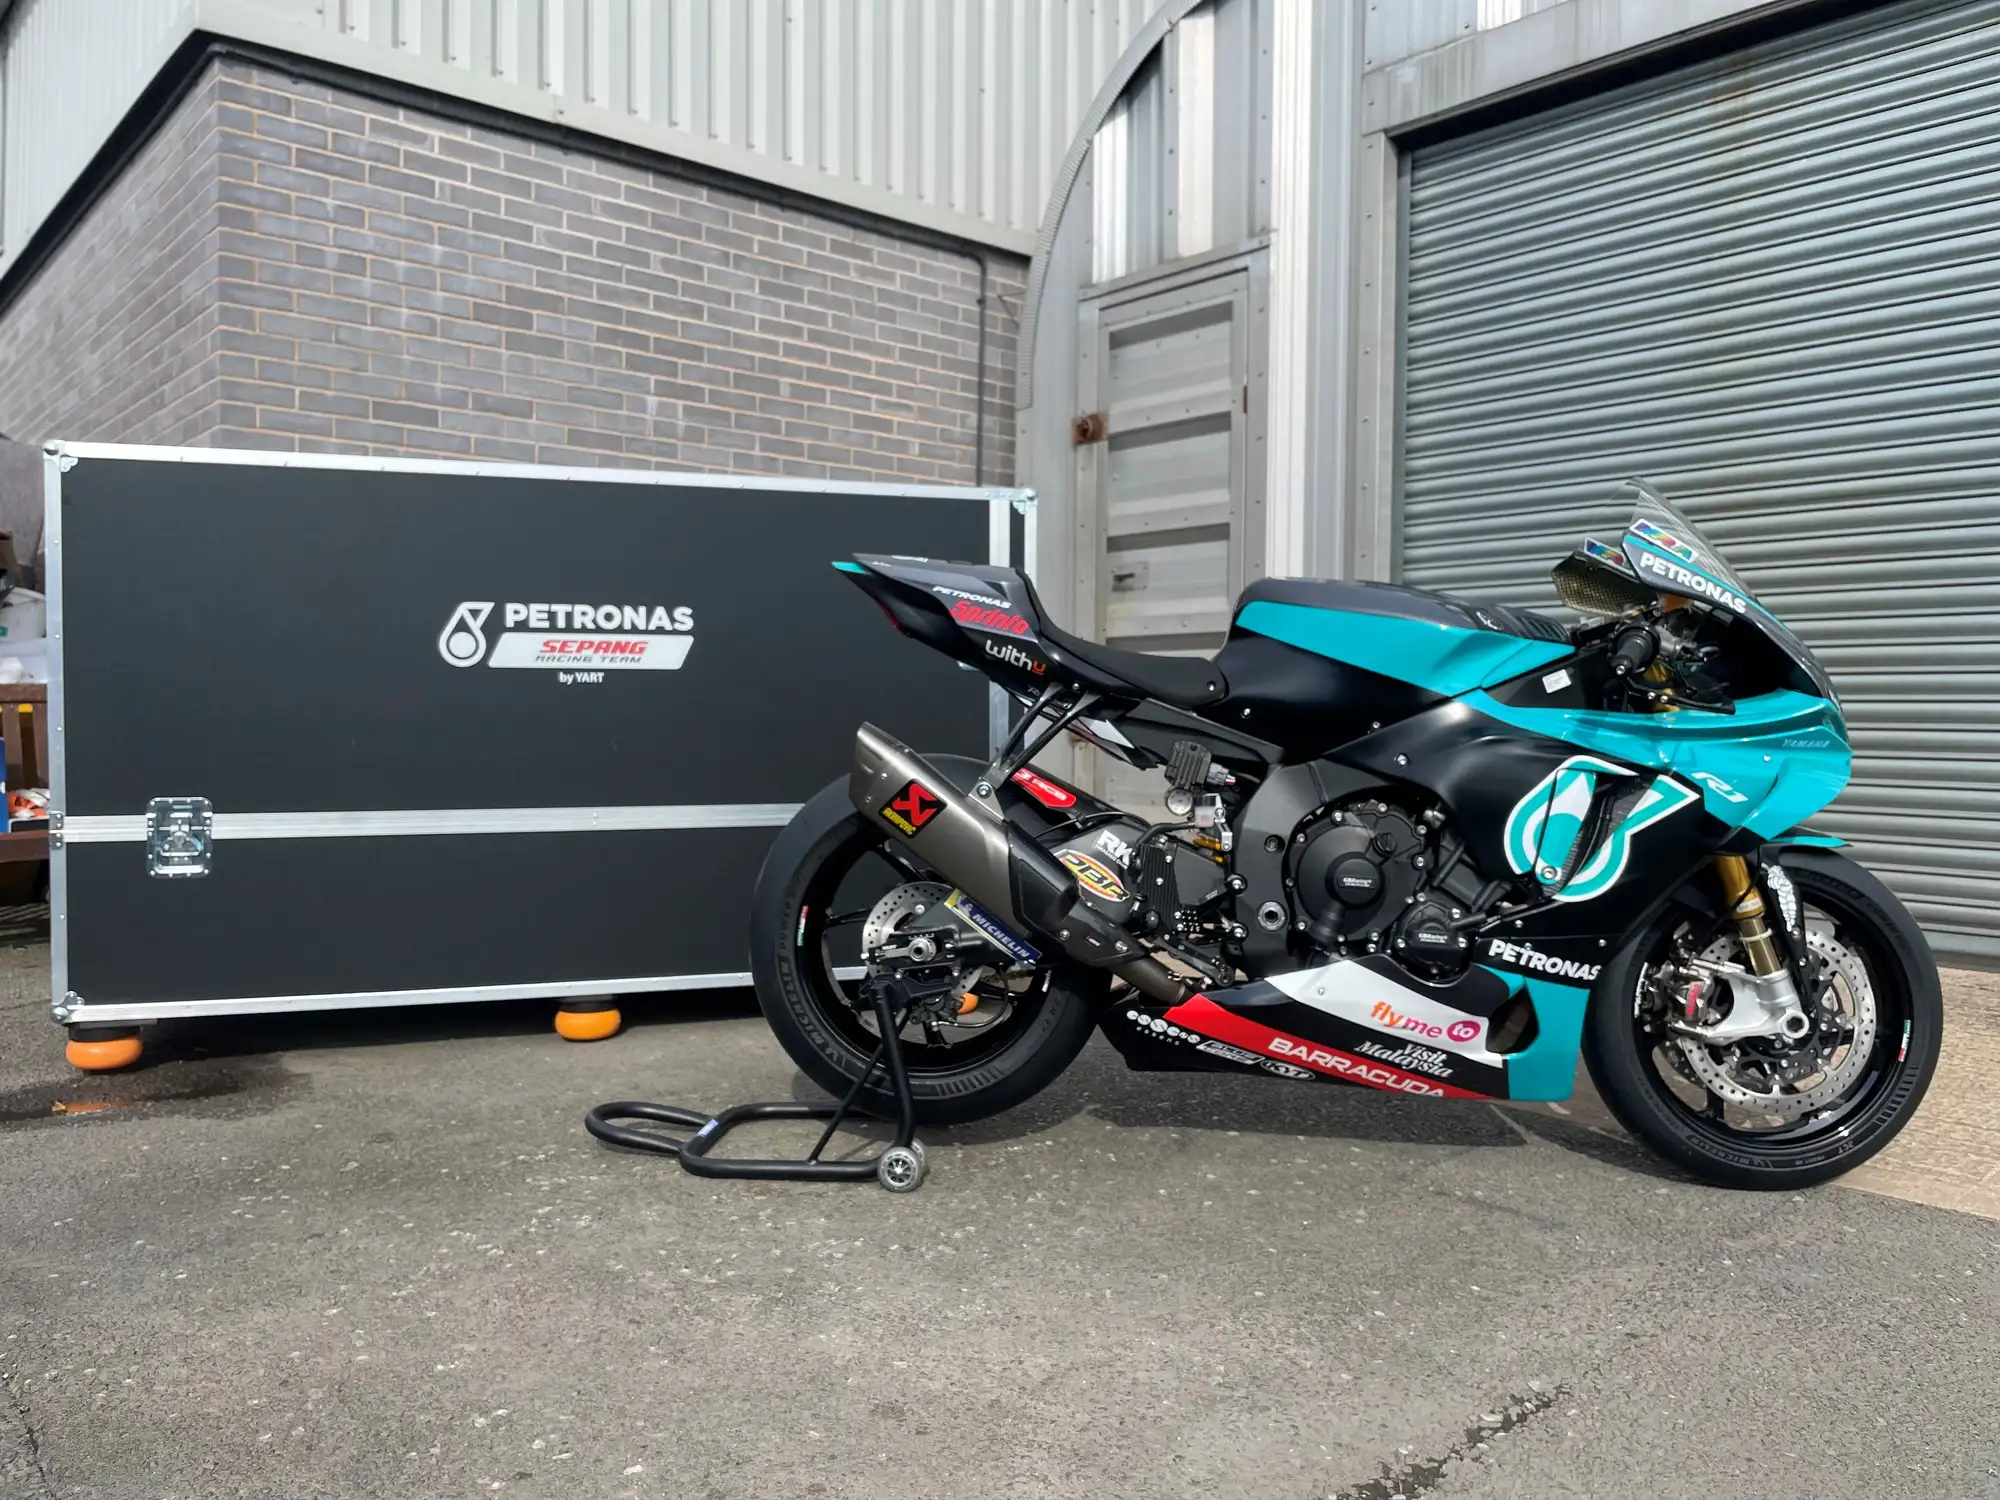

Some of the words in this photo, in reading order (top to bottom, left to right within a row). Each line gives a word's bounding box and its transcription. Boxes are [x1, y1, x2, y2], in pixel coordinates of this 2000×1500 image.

[932, 586, 1012, 609] PETRONAS
[1640, 552, 1747, 613] PETRONAS
[505, 603, 694, 631] PETRONAS
[535, 655, 593, 664] RACING
[599, 656, 642, 664] TEAM
[539, 640, 649, 655] SEPANG
[559, 672, 574, 685] by
[576, 672, 605, 683] YART
[1096, 830, 1132, 866] RK
[972, 912, 1030, 958] MICHELIN
[1489, 939, 1601, 981] PETRONAS
[1268, 1037, 1445, 1097] BARRACUDA
[1353, 1040, 1453, 1078] Malaysia
[1402, 1043, 1445, 1065] Visit
